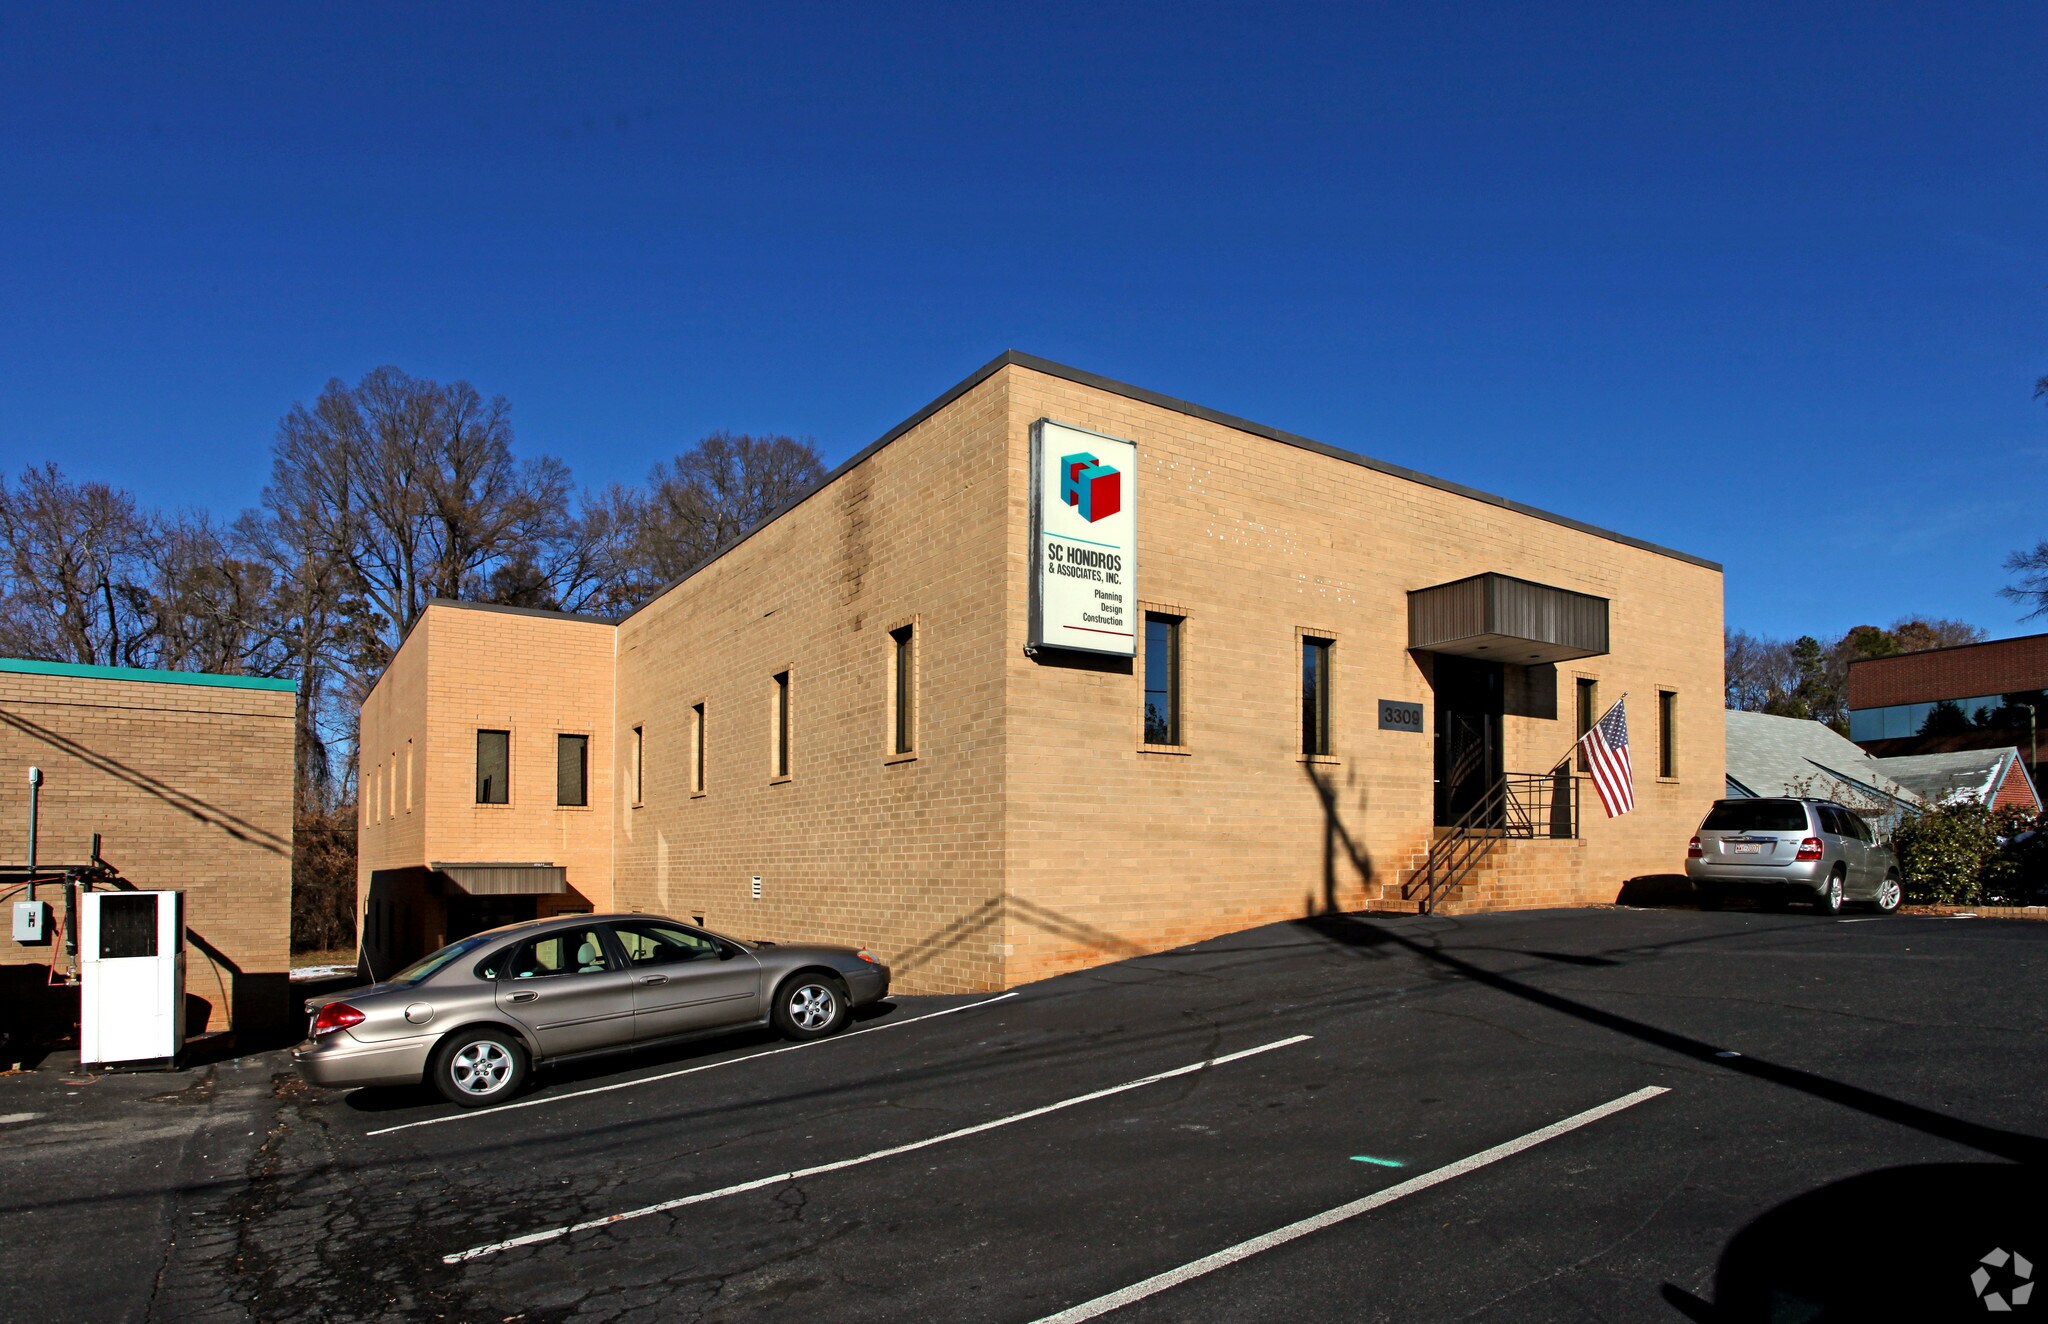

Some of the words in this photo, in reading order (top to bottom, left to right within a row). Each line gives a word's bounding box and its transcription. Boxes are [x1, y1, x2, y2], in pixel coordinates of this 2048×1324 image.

[1048, 543, 1063, 561] SC
[1067, 546, 1121, 571] HONDROS
[1048, 562, 1055, 574] &
[1057, 563, 1104, 584] ASSOCIATES,
[1105, 572, 1122, 585] INC.
[1094, 589, 1122, 603] Planning
[1101, 602, 1123, 615] Design
[1082, 612, 1123, 626] Construction
[1384, 707, 1420, 725] 3309
